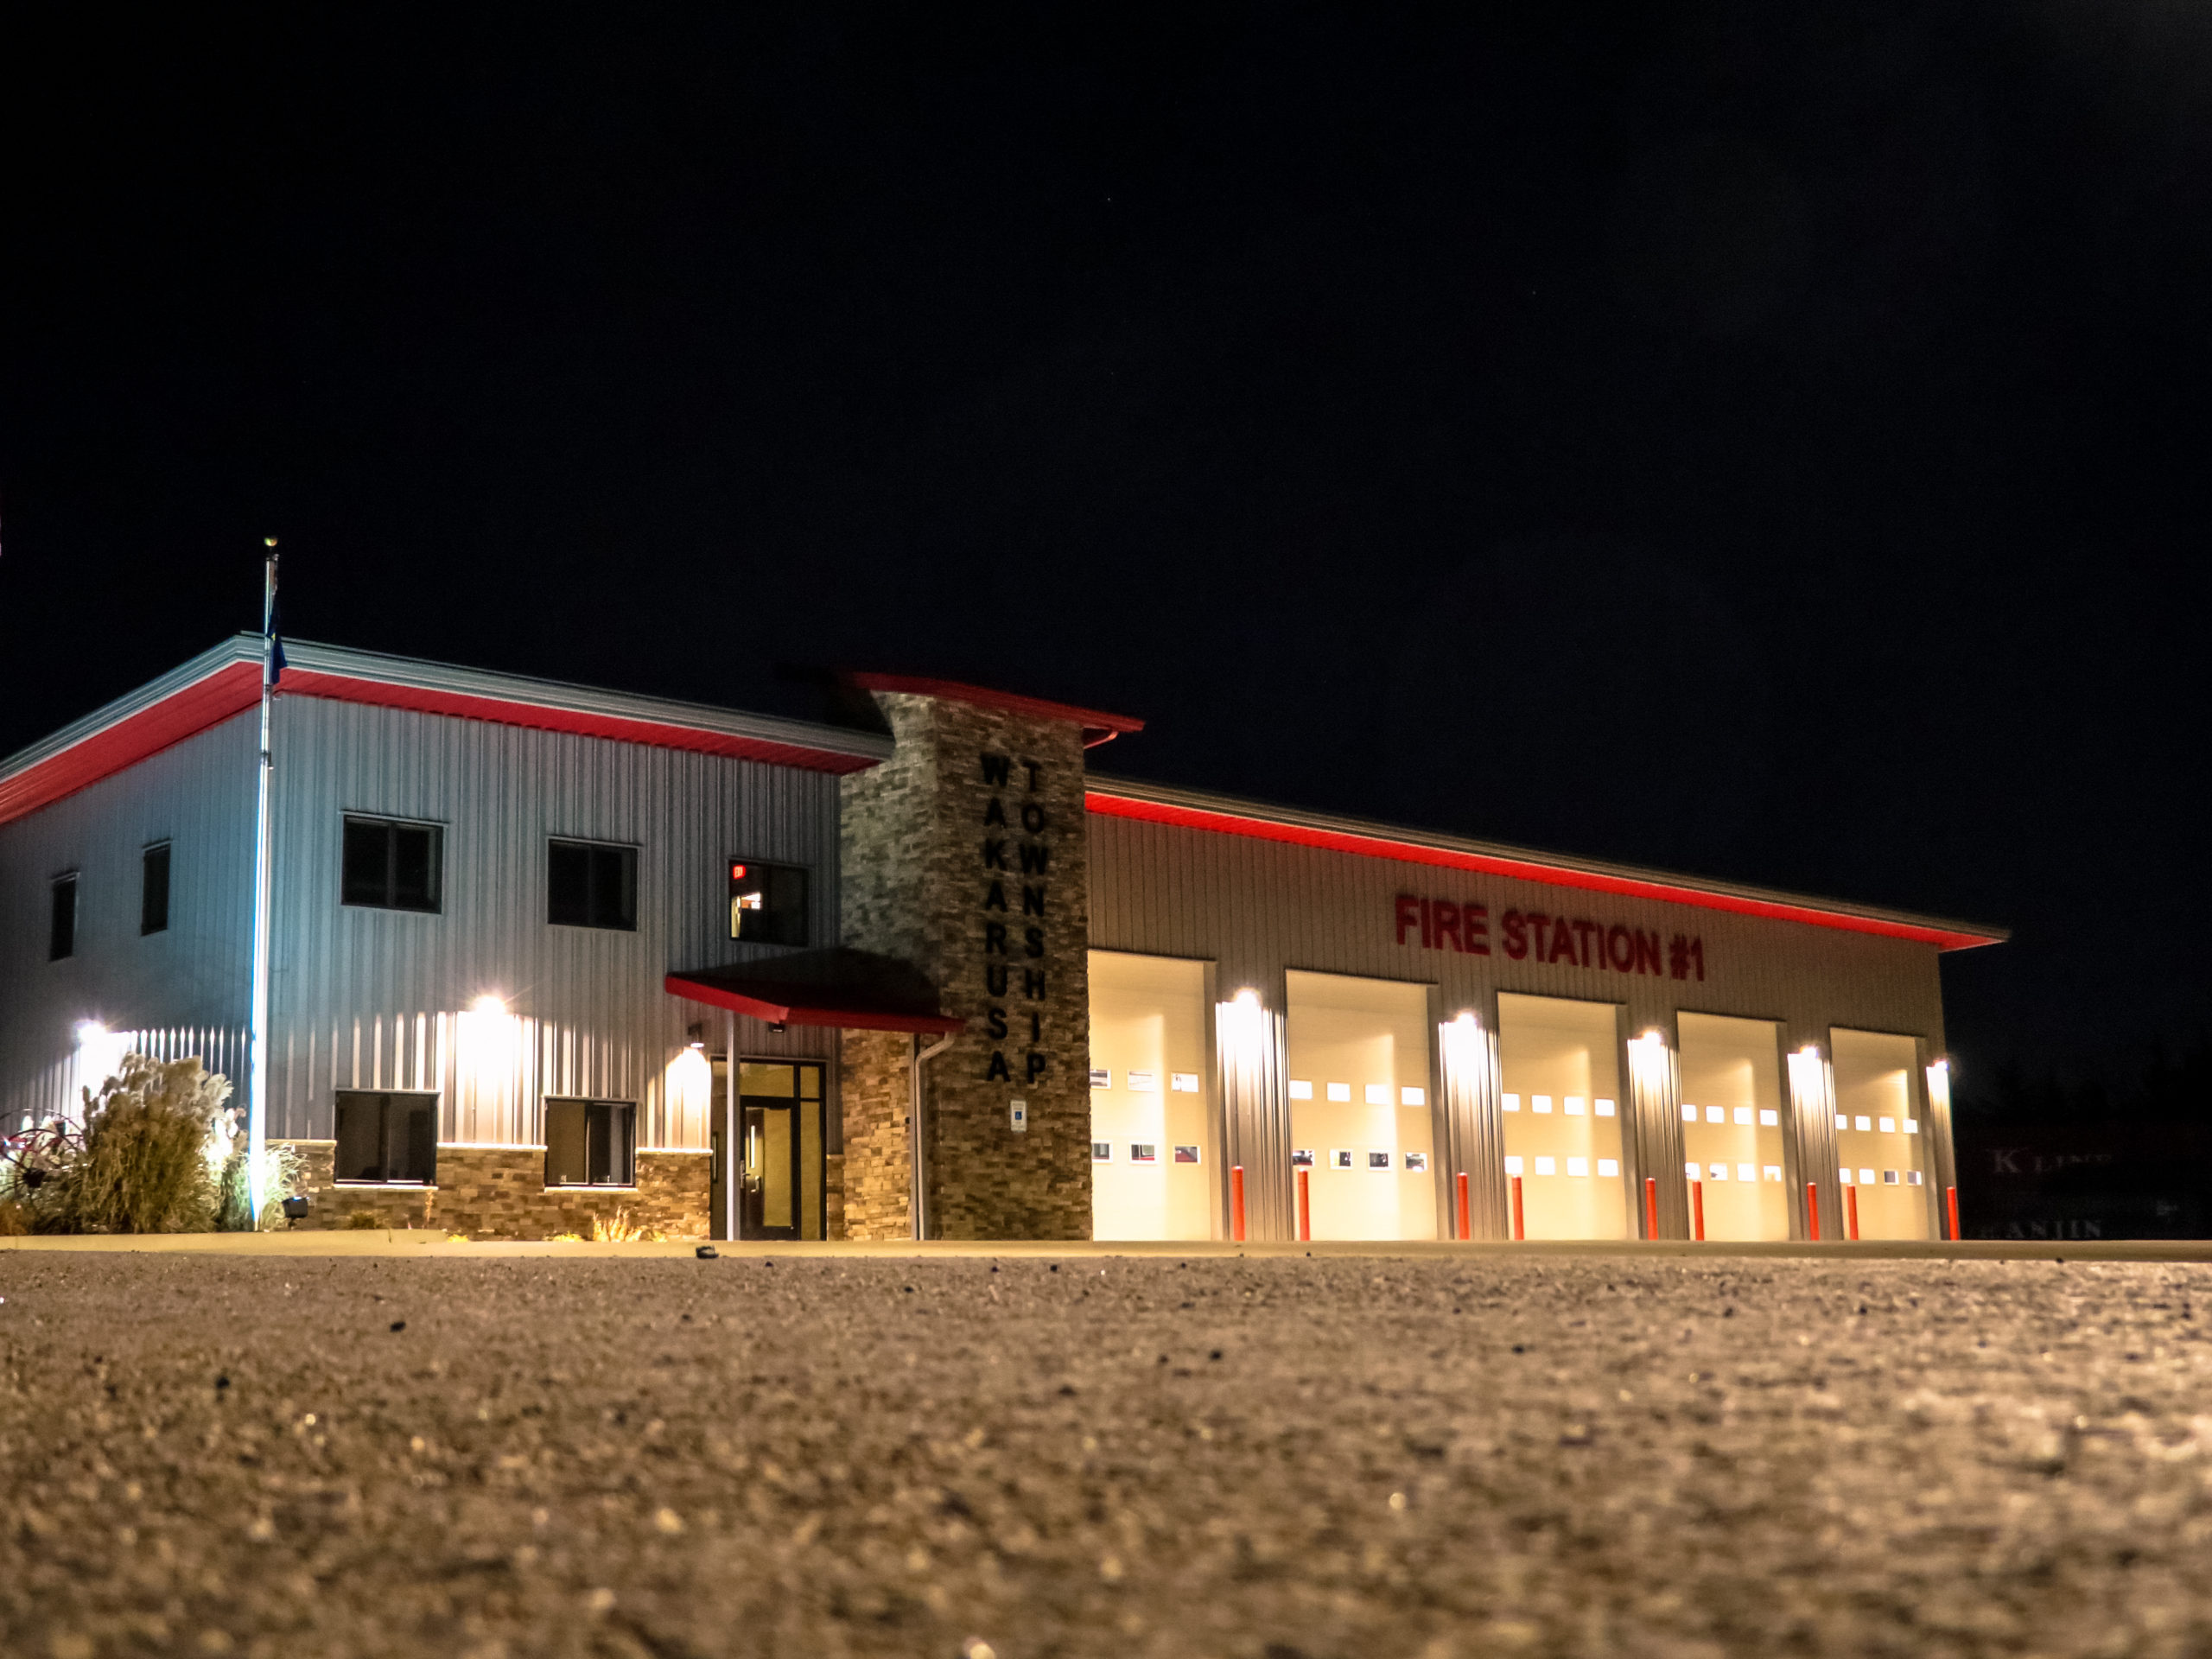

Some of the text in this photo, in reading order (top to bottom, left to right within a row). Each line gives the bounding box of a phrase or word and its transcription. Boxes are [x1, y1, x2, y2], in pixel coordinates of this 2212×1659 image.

[980, 753, 1010, 1083] WAKARUSA
[1019, 760, 1048, 1084] TOWNSHIP
[1395, 894, 1706, 981] FIRE STATION #1
